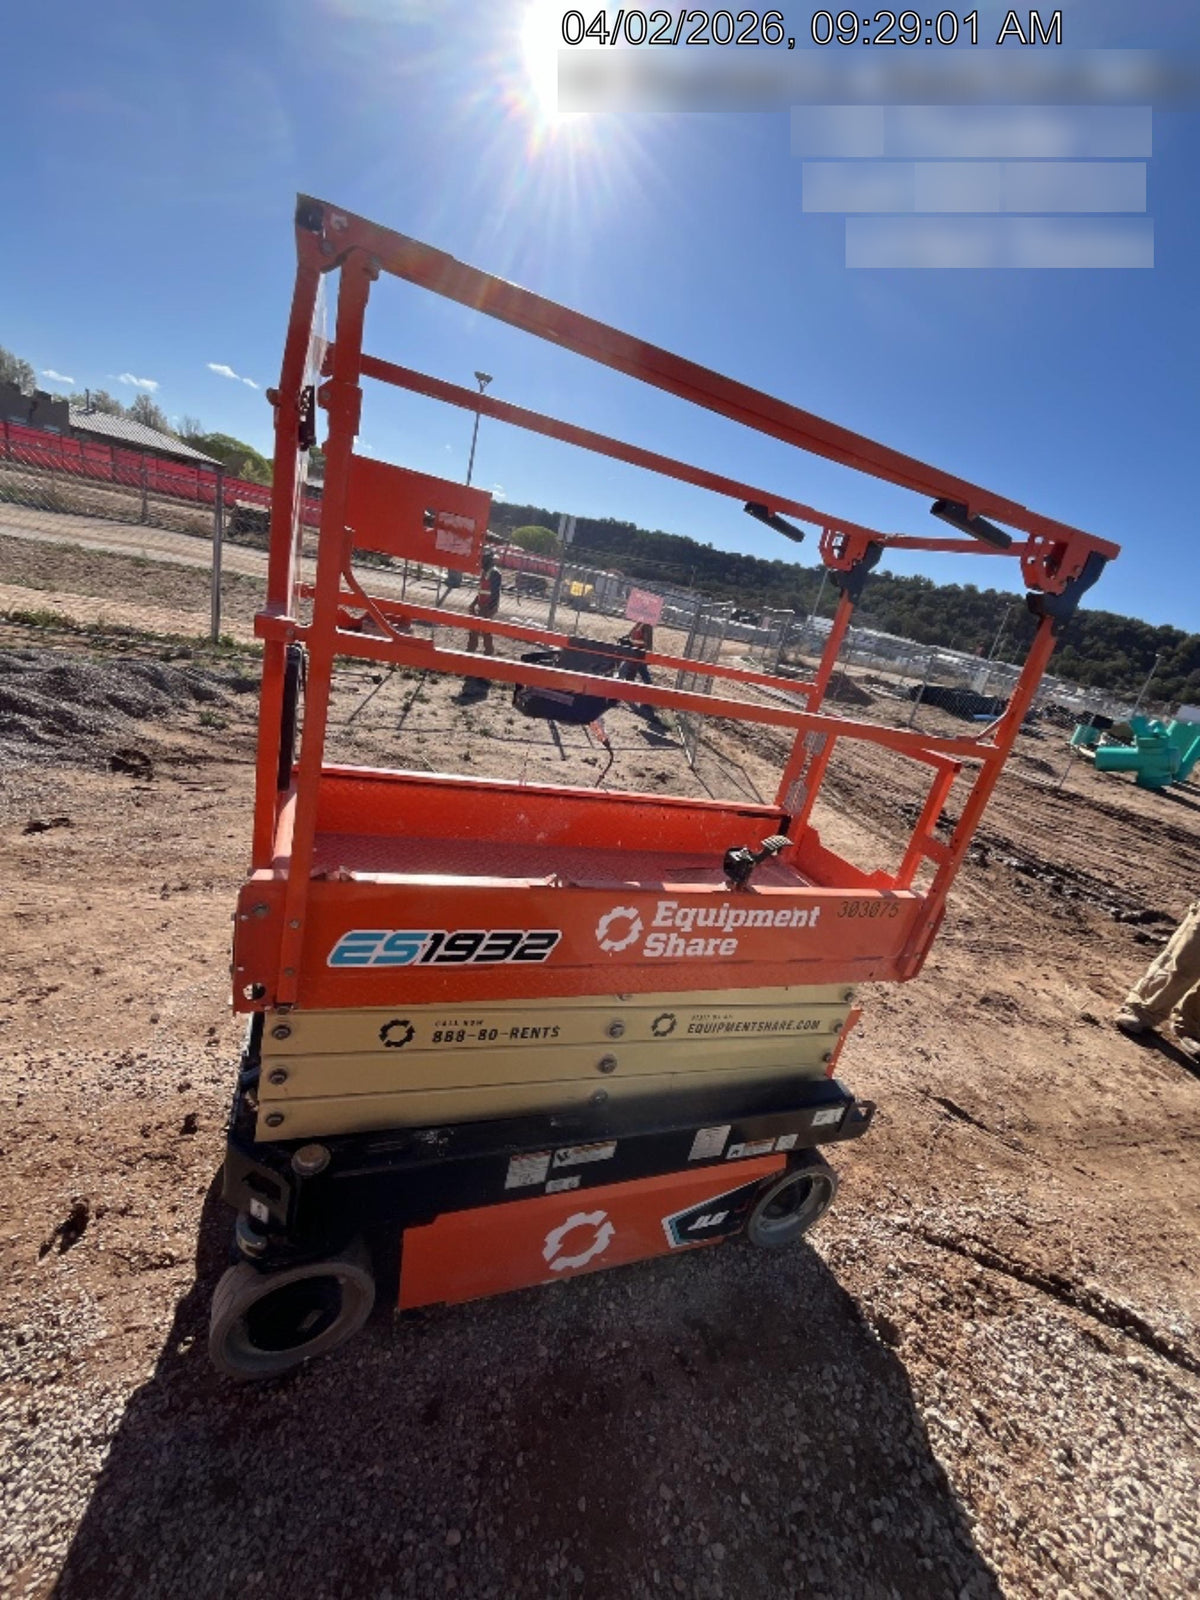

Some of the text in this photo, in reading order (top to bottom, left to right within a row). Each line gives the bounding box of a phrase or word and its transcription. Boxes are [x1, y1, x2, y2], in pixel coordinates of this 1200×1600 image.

[652, 900, 820, 932] Equipment
[837, 900, 900, 918] 303075
[326, 929, 563, 968] ES1932
[643, 933, 738, 957] Share
[688, 1019, 821, 1034] EQUIPMENTSHARE.COM
